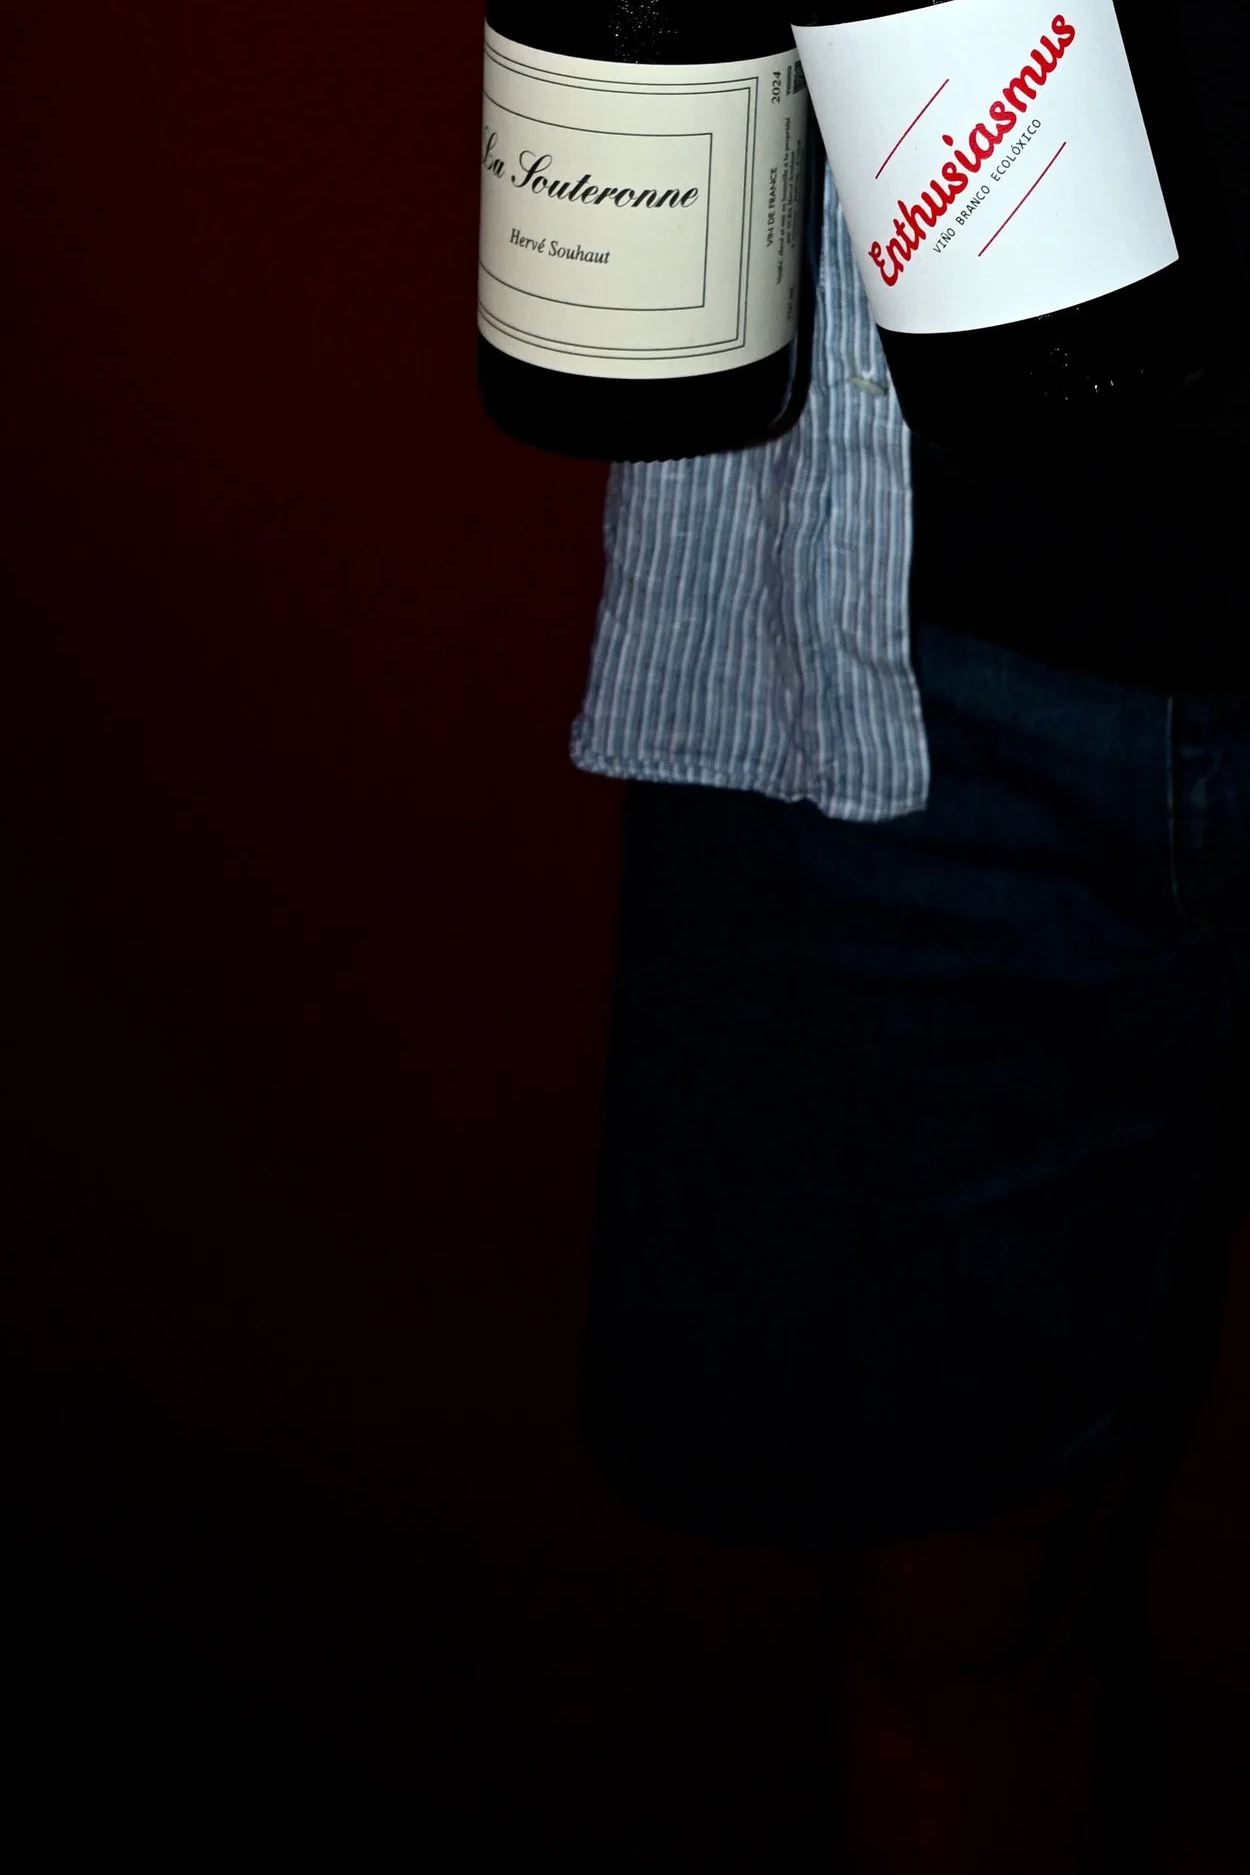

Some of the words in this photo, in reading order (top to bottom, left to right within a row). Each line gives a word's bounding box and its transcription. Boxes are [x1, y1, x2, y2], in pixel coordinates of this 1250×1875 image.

[771, 71, 782, 105] 2024
[868, 14, 1077, 287] Enthusiasmus
[511, 150, 699, 208] Souteronne
[769, 167, 778, 210] FRANCE
[933, 227, 956, 254] VIÑO
[955, 185, 990, 226] BRANCO
[990, 119, 1042, 182] ECOLÓXICO
[766, 227, 774, 248] VIN
[768, 212, 776, 225] DE
[509, 228, 545, 254] Hervé
[548, 240, 611, 265] Souhaut
